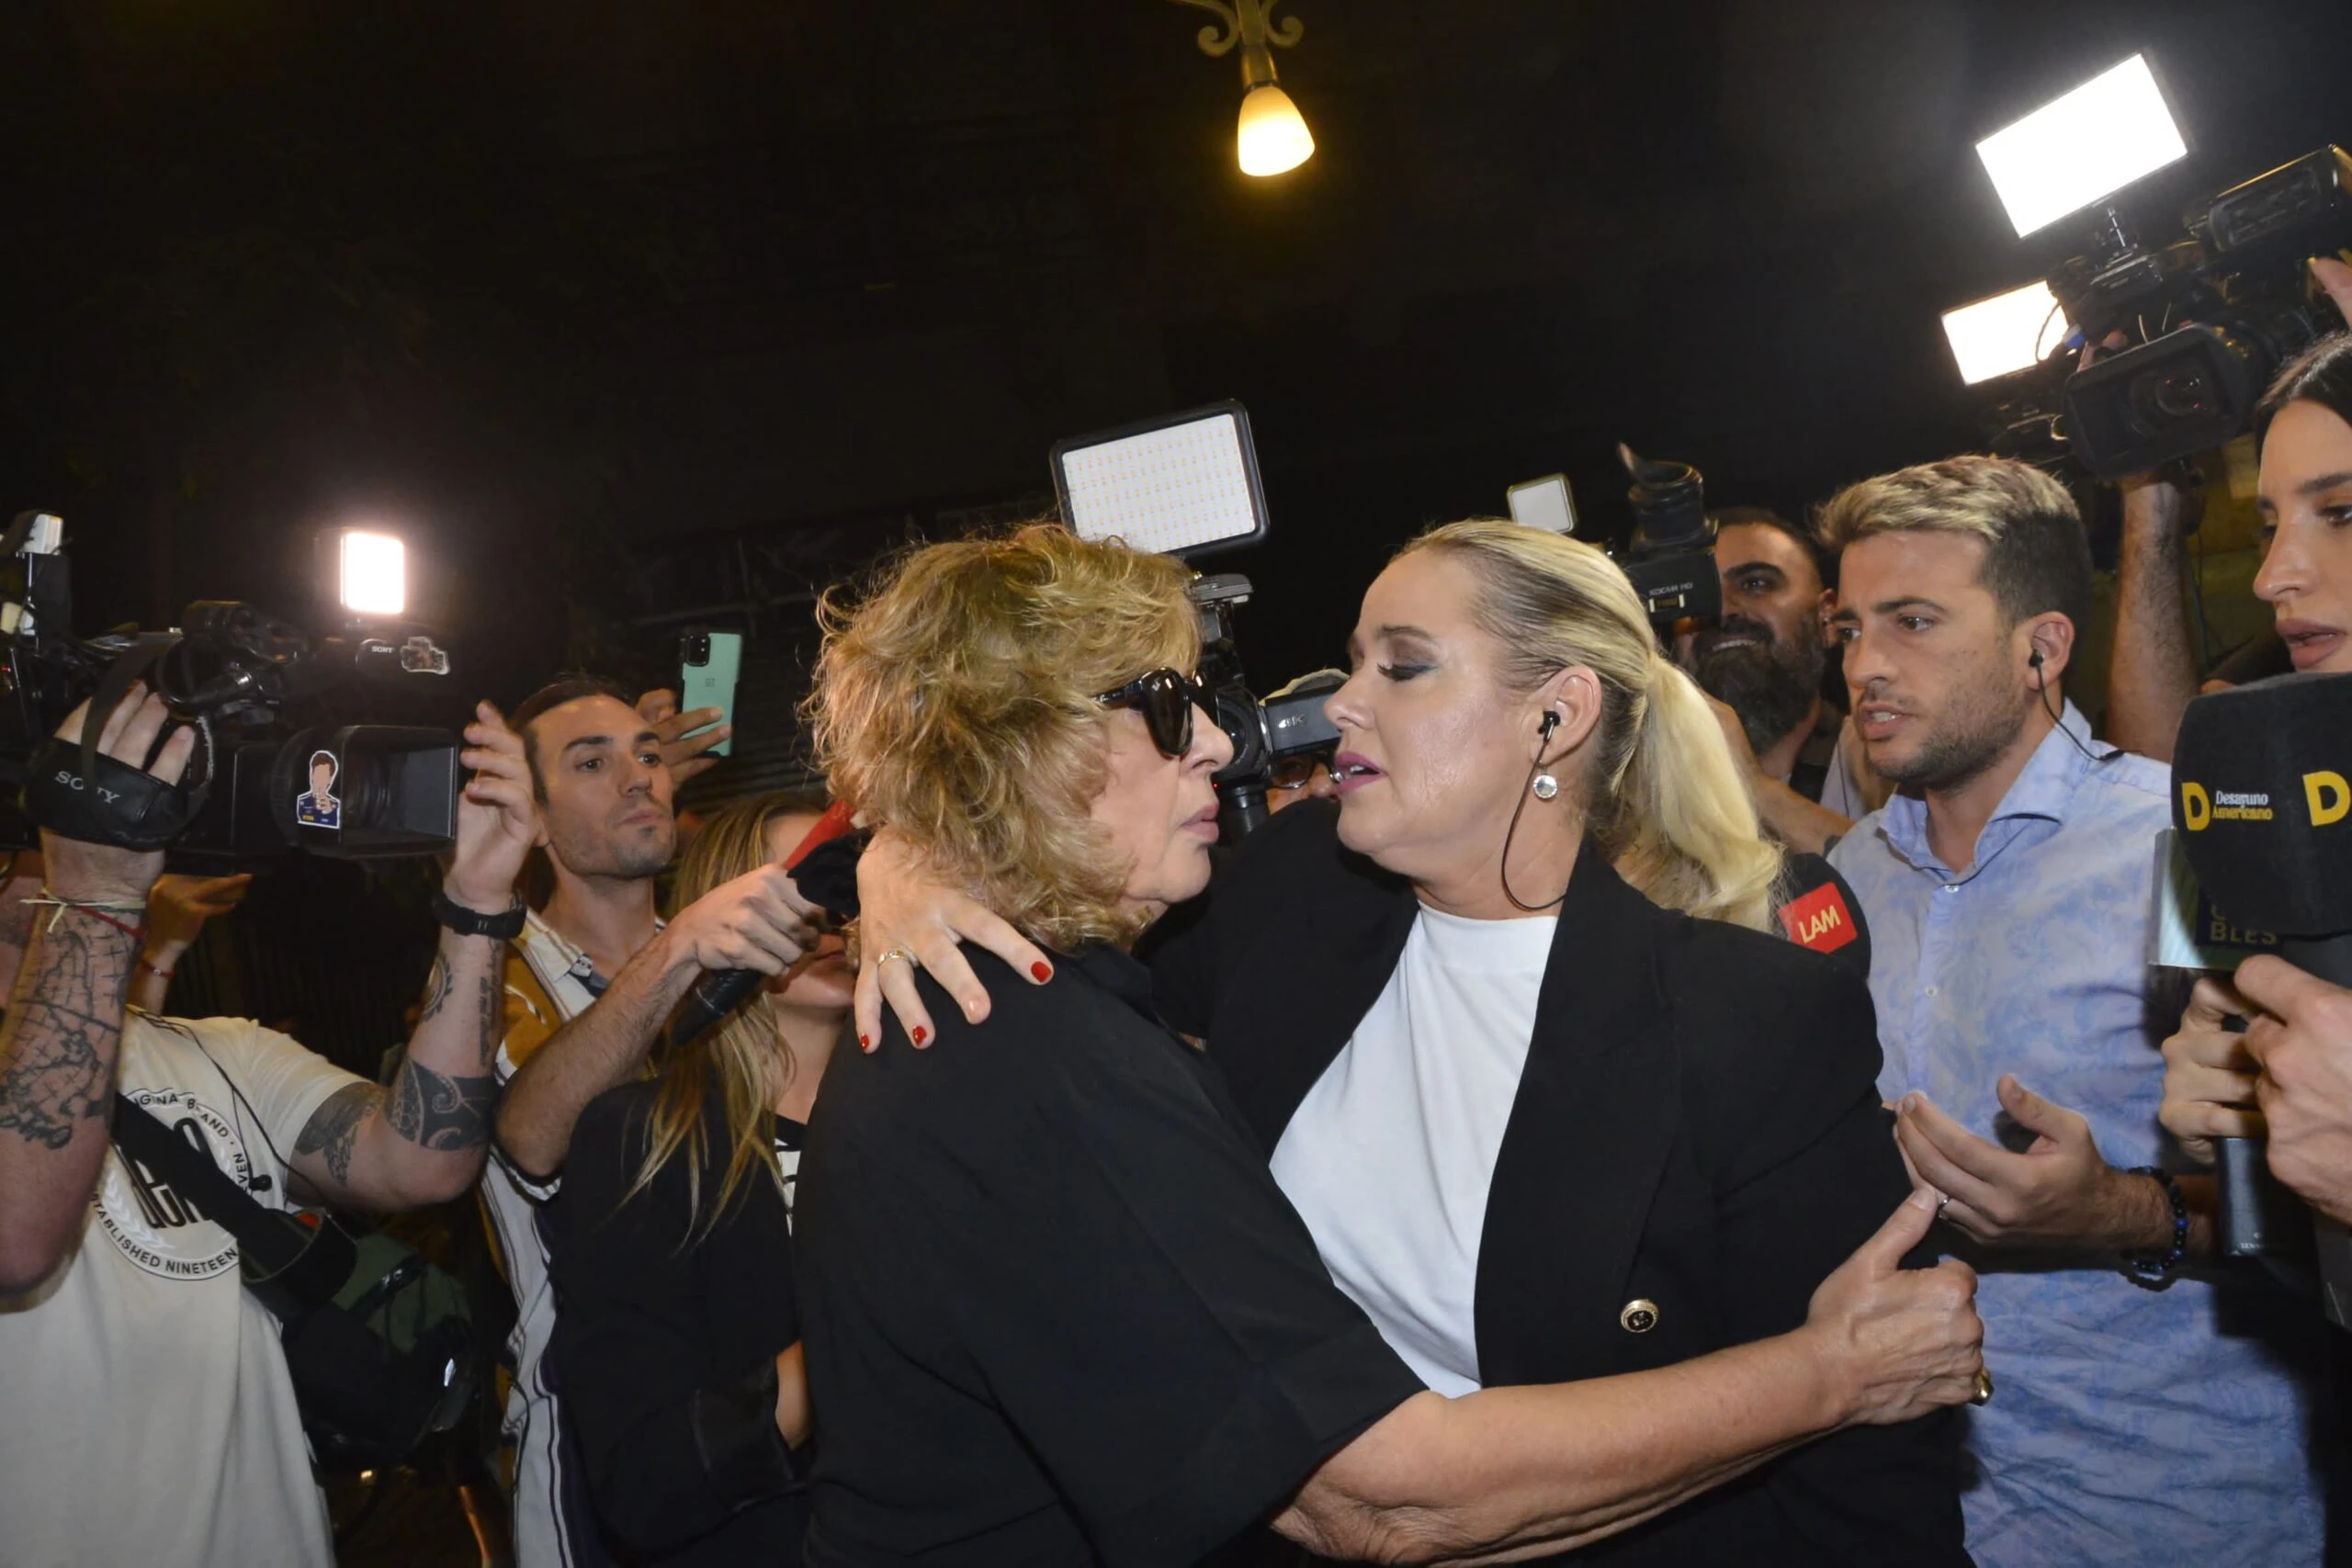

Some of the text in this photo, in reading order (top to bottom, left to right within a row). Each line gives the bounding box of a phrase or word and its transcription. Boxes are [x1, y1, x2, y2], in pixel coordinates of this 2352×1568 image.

[371, 646, 393, 654] SONY
[2181, 782, 2211, 831] D
[2211, 806, 2275, 820] Americano
[2302, 770, 2351, 827] D
[1798, 905, 1841, 944] LAM
[164, 1247, 239, 1275] NINETEEN
